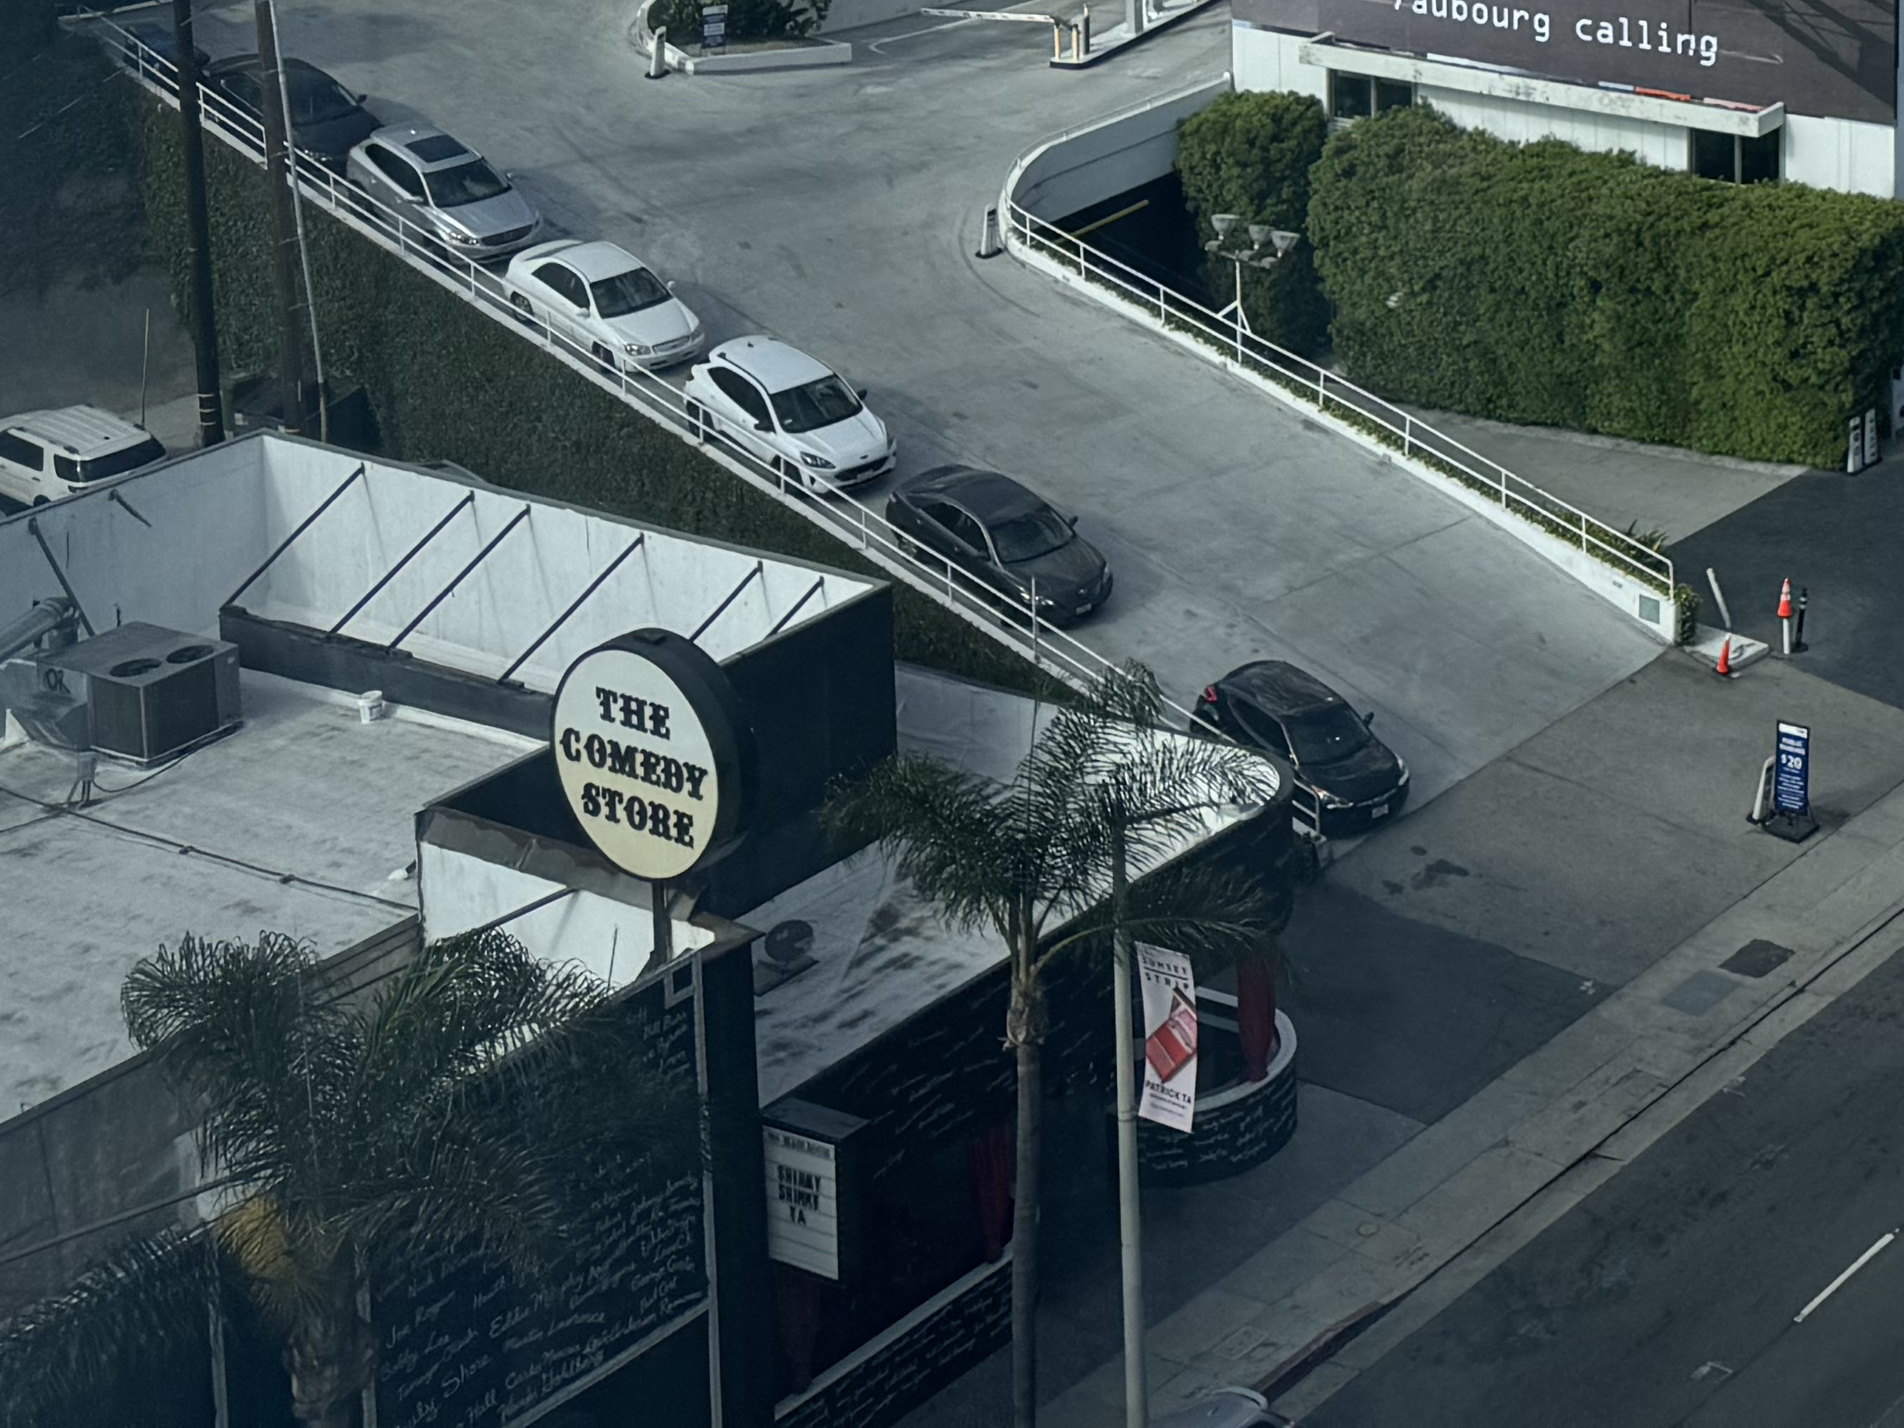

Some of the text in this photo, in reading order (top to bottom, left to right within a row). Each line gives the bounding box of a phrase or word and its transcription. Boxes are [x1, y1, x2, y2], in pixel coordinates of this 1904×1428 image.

[1575, 17, 1719, 67] calling
[596, 686, 670, 741] THE
[560, 727, 708, 801] COMEDY
[581, 782, 694, 849] STORE
[1142, 956, 1188, 976] SUNSET
[1145, 972, 1190, 990] STRIP
[1145, 1079, 1192, 1105] PATRICK TA
